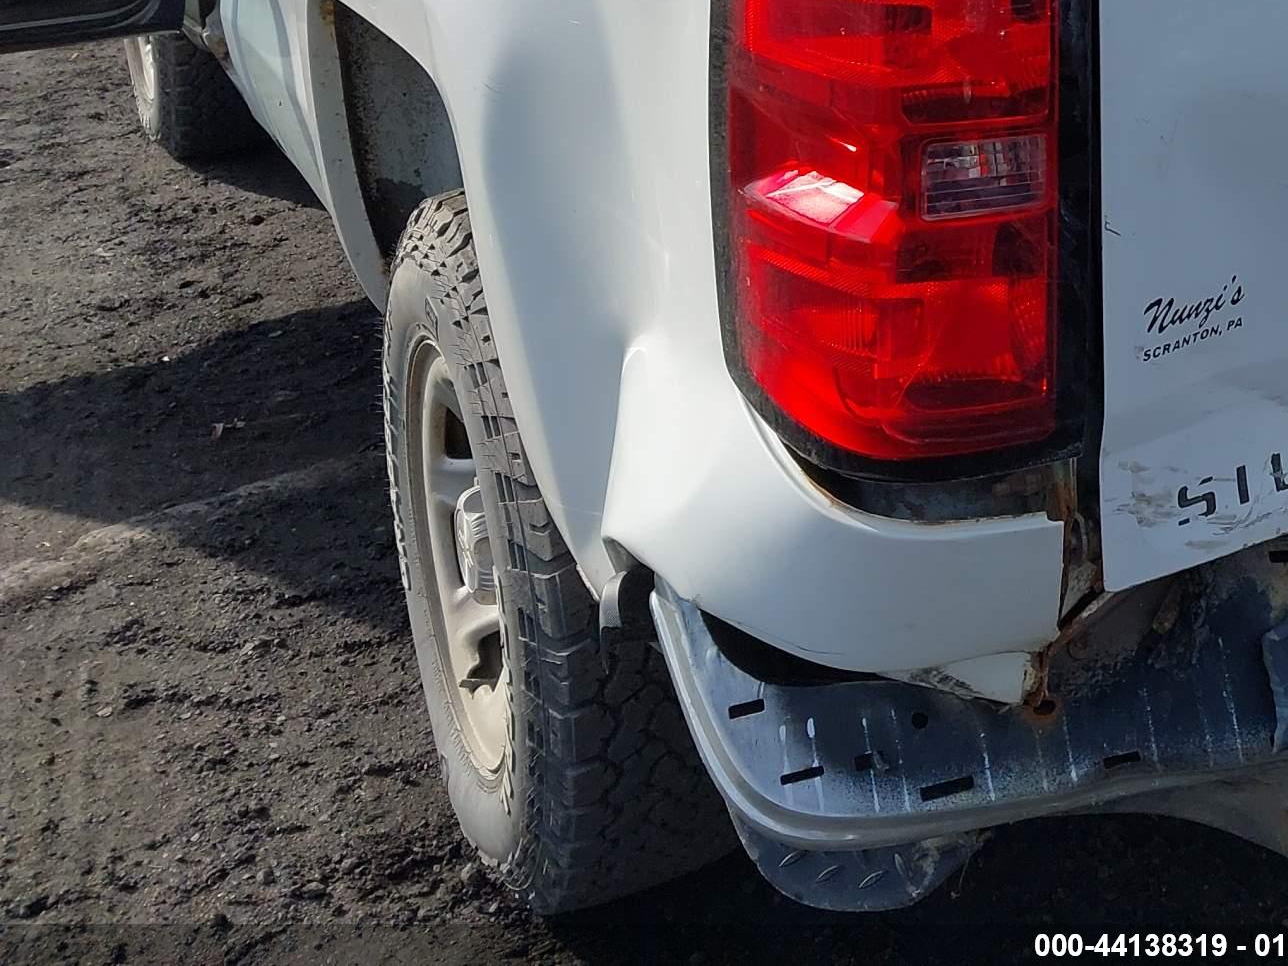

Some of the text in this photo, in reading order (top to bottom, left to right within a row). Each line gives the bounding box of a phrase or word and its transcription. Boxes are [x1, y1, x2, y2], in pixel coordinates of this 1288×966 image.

[1143, 275, 1245, 333] Nunzi's
[1142, 317, 1243, 362] SCRANTON, PA
